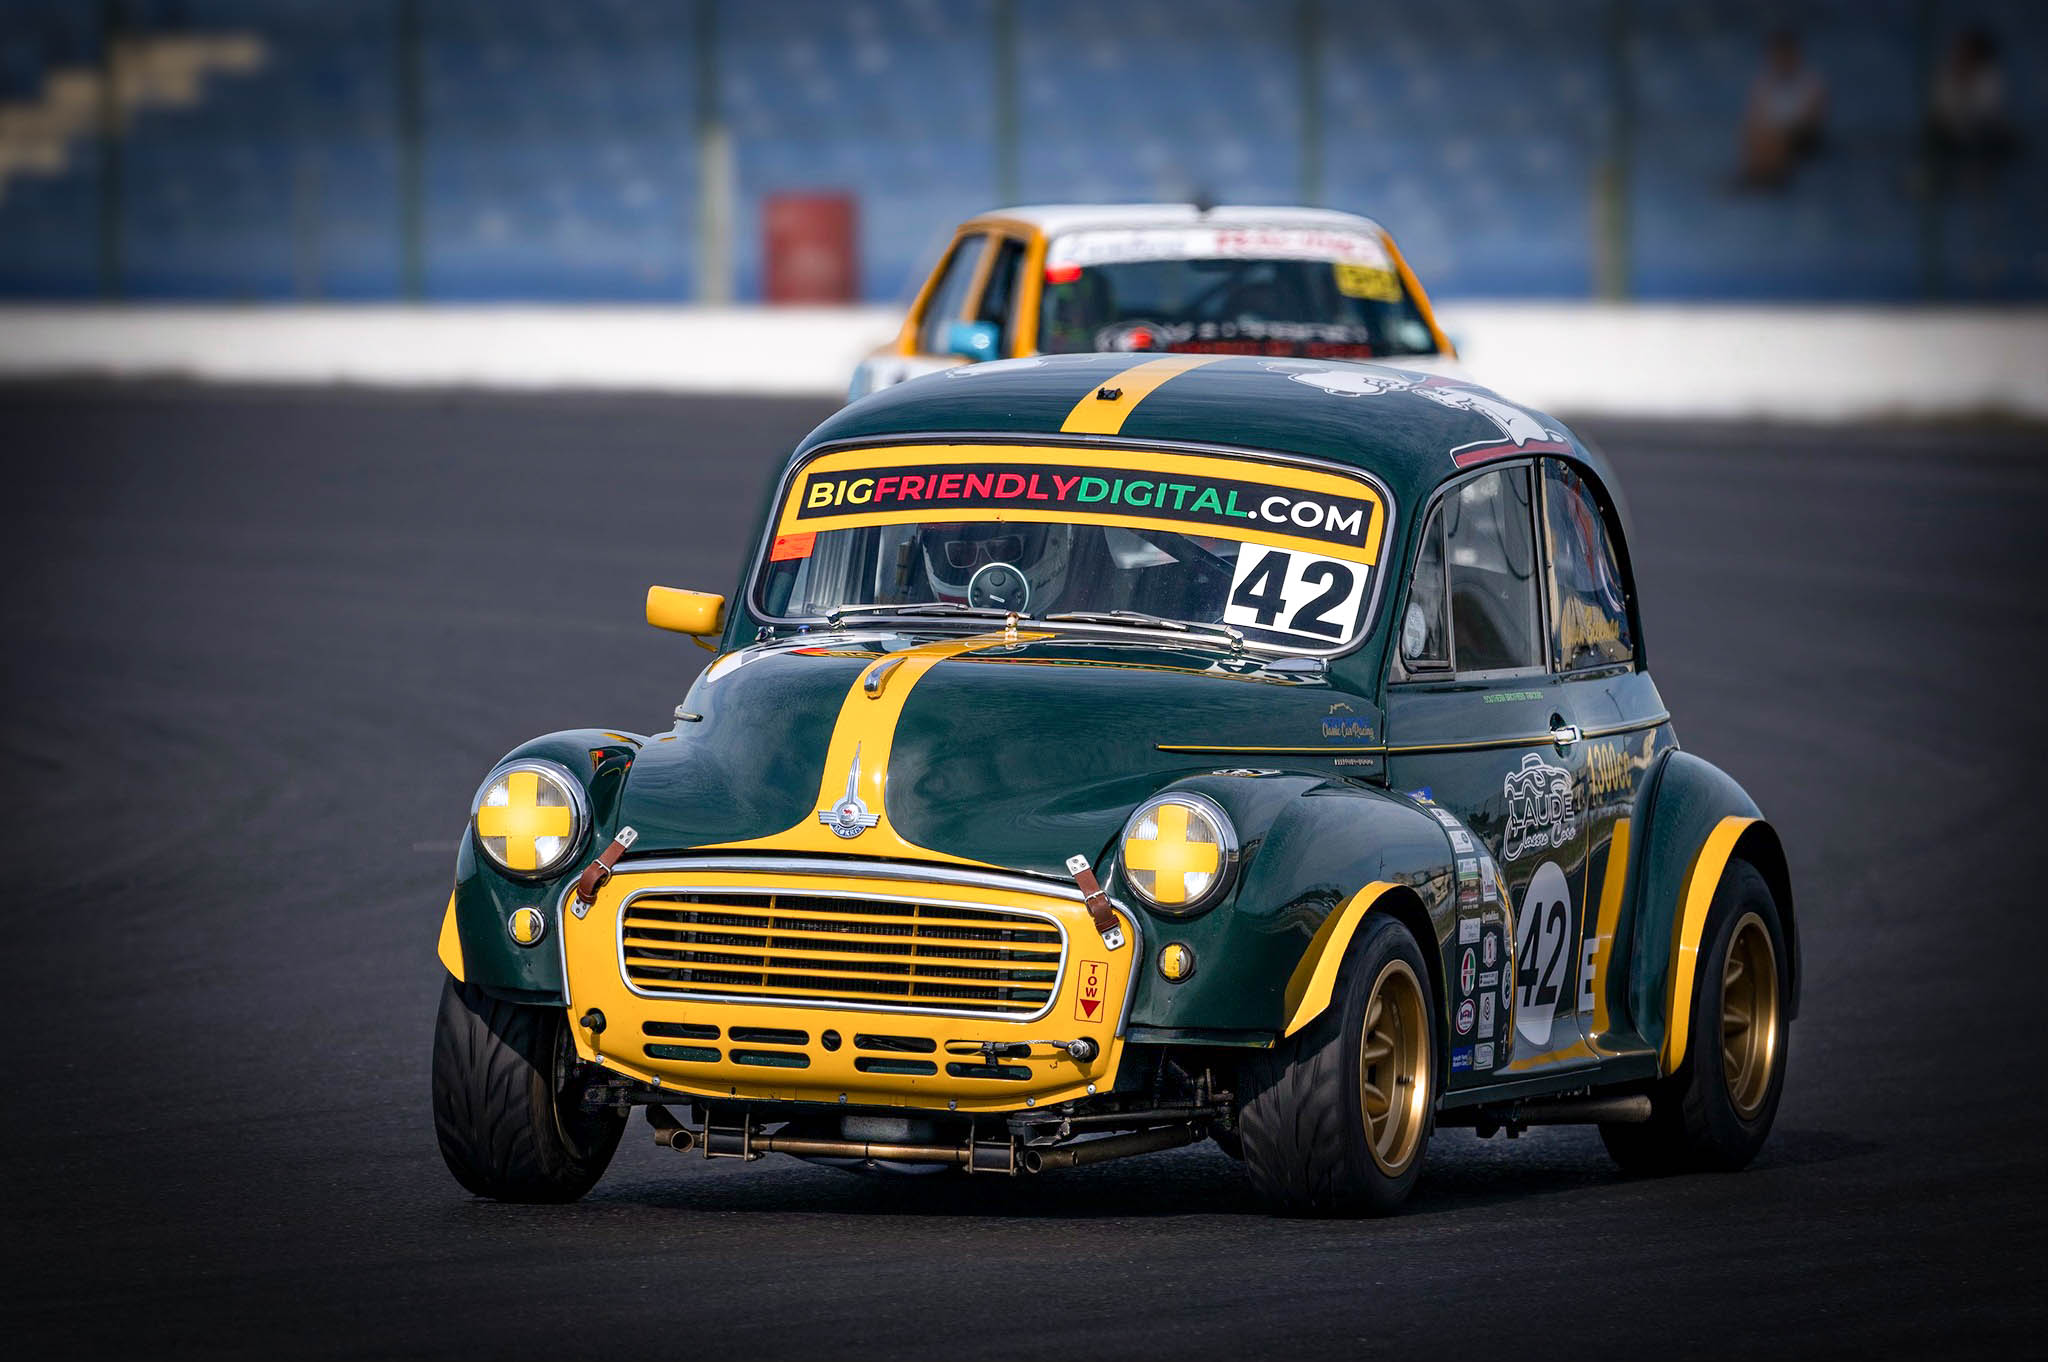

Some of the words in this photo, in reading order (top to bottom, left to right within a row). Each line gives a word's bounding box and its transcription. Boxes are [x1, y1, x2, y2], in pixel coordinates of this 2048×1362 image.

[807, 473, 1363, 536] BIGFRIENDLYDIGITAL.COM
[1231, 550, 1354, 639] 42
[1587, 741, 1632, 797] 1300cc
[1504, 815, 1549, 861] Classic
[1509, 792, 1575, 831] LAUDE
[1085, 964, 1098, 998] TOW
[1517, 900, 1566, 1007] 42
